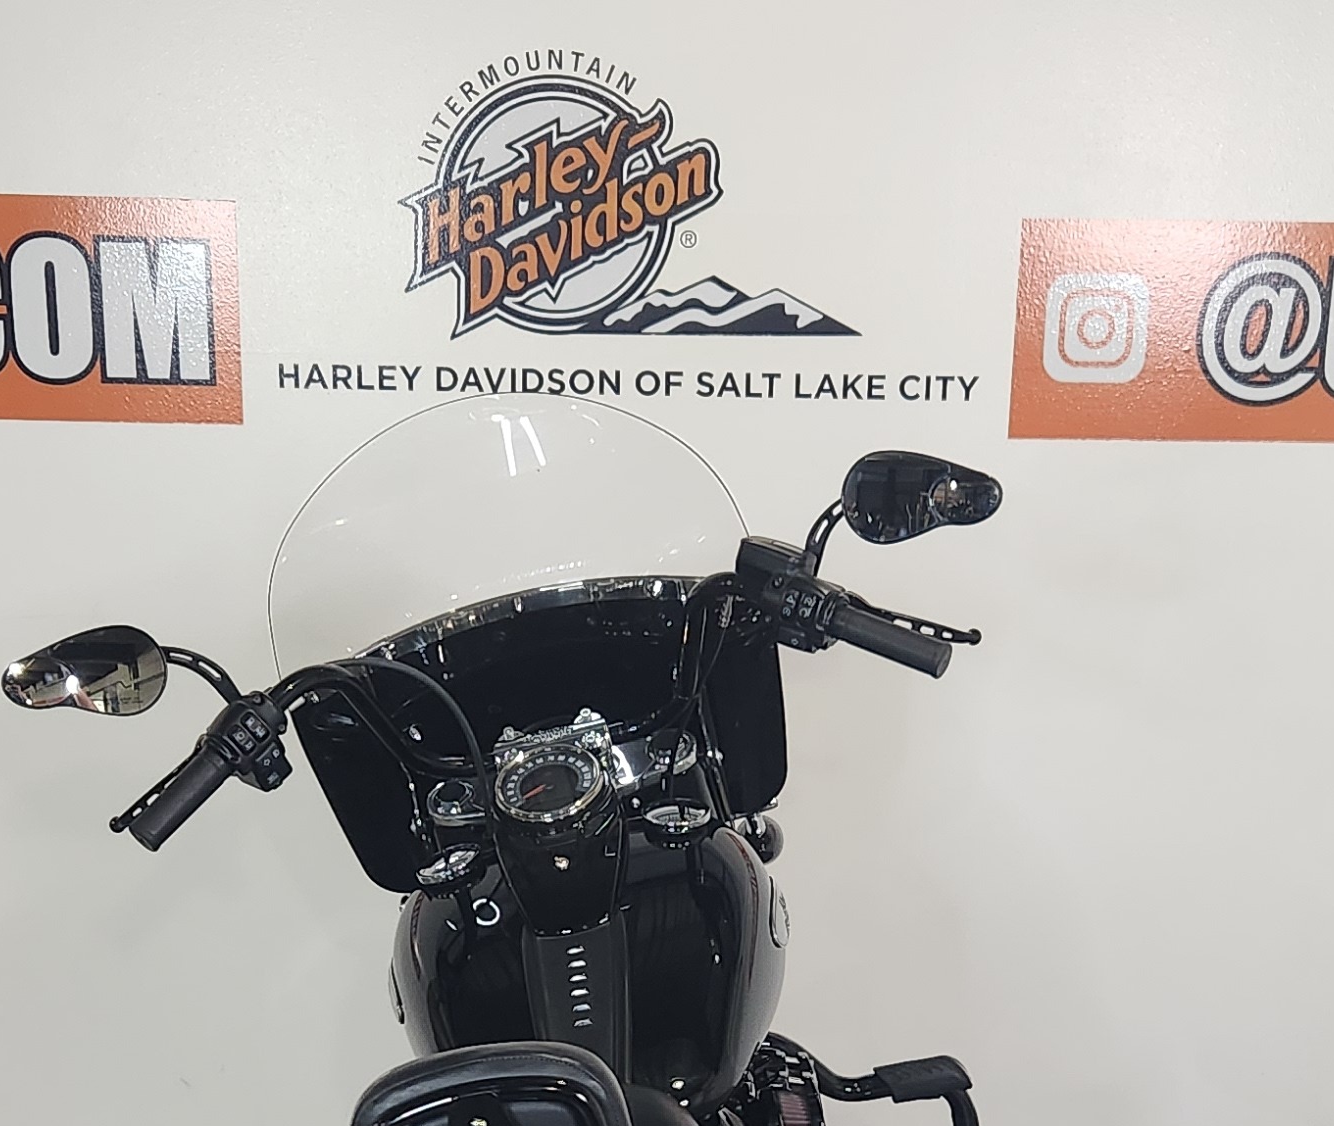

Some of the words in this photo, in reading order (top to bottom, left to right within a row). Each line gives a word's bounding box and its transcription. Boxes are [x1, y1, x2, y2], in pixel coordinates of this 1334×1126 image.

[418, 48, 638, 165] INTERMOUNTAIN
[466, 147, 710, 317] Davidson
[278, 363, 421, 393] HARLEY
[436, 366, 621, 396] DAVIDSON
[635, 370, 683, 396] OF
[696, 371, 782, 398] SALT
[794, 373, 885, 400] LAKE
[899, 375, 980, 402] CITY
